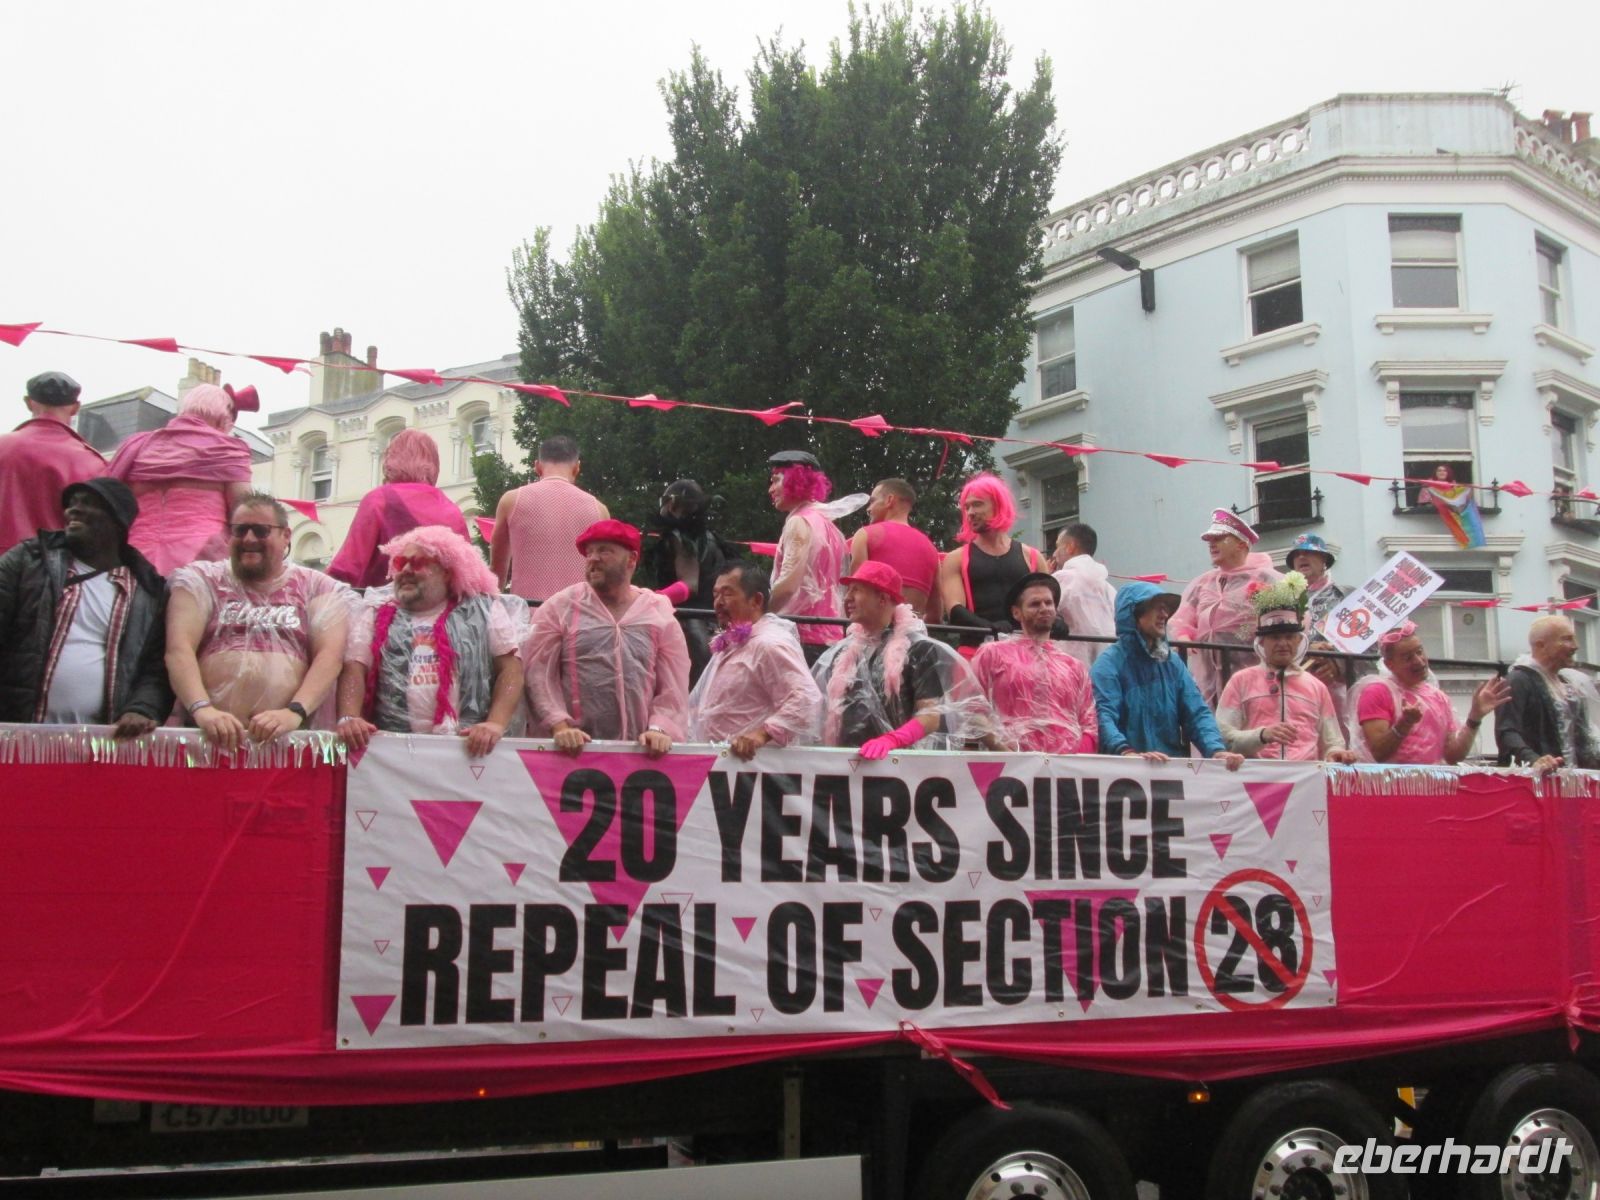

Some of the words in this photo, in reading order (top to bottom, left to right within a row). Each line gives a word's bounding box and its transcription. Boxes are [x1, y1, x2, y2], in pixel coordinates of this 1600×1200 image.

[1375, 588, 1410, 617] WALLS!
[559, 769, 677, 883] 20
[708, 771, 961, 883] YEARS
[985, 777, 1187, 881] SINCE
[400, 902, 737, 1026] REPEAL
[766, 901, 863, 1015] OF
[891, 896, 1189, 1011] SECTION
[1210, 894, 1298, 994] 28
